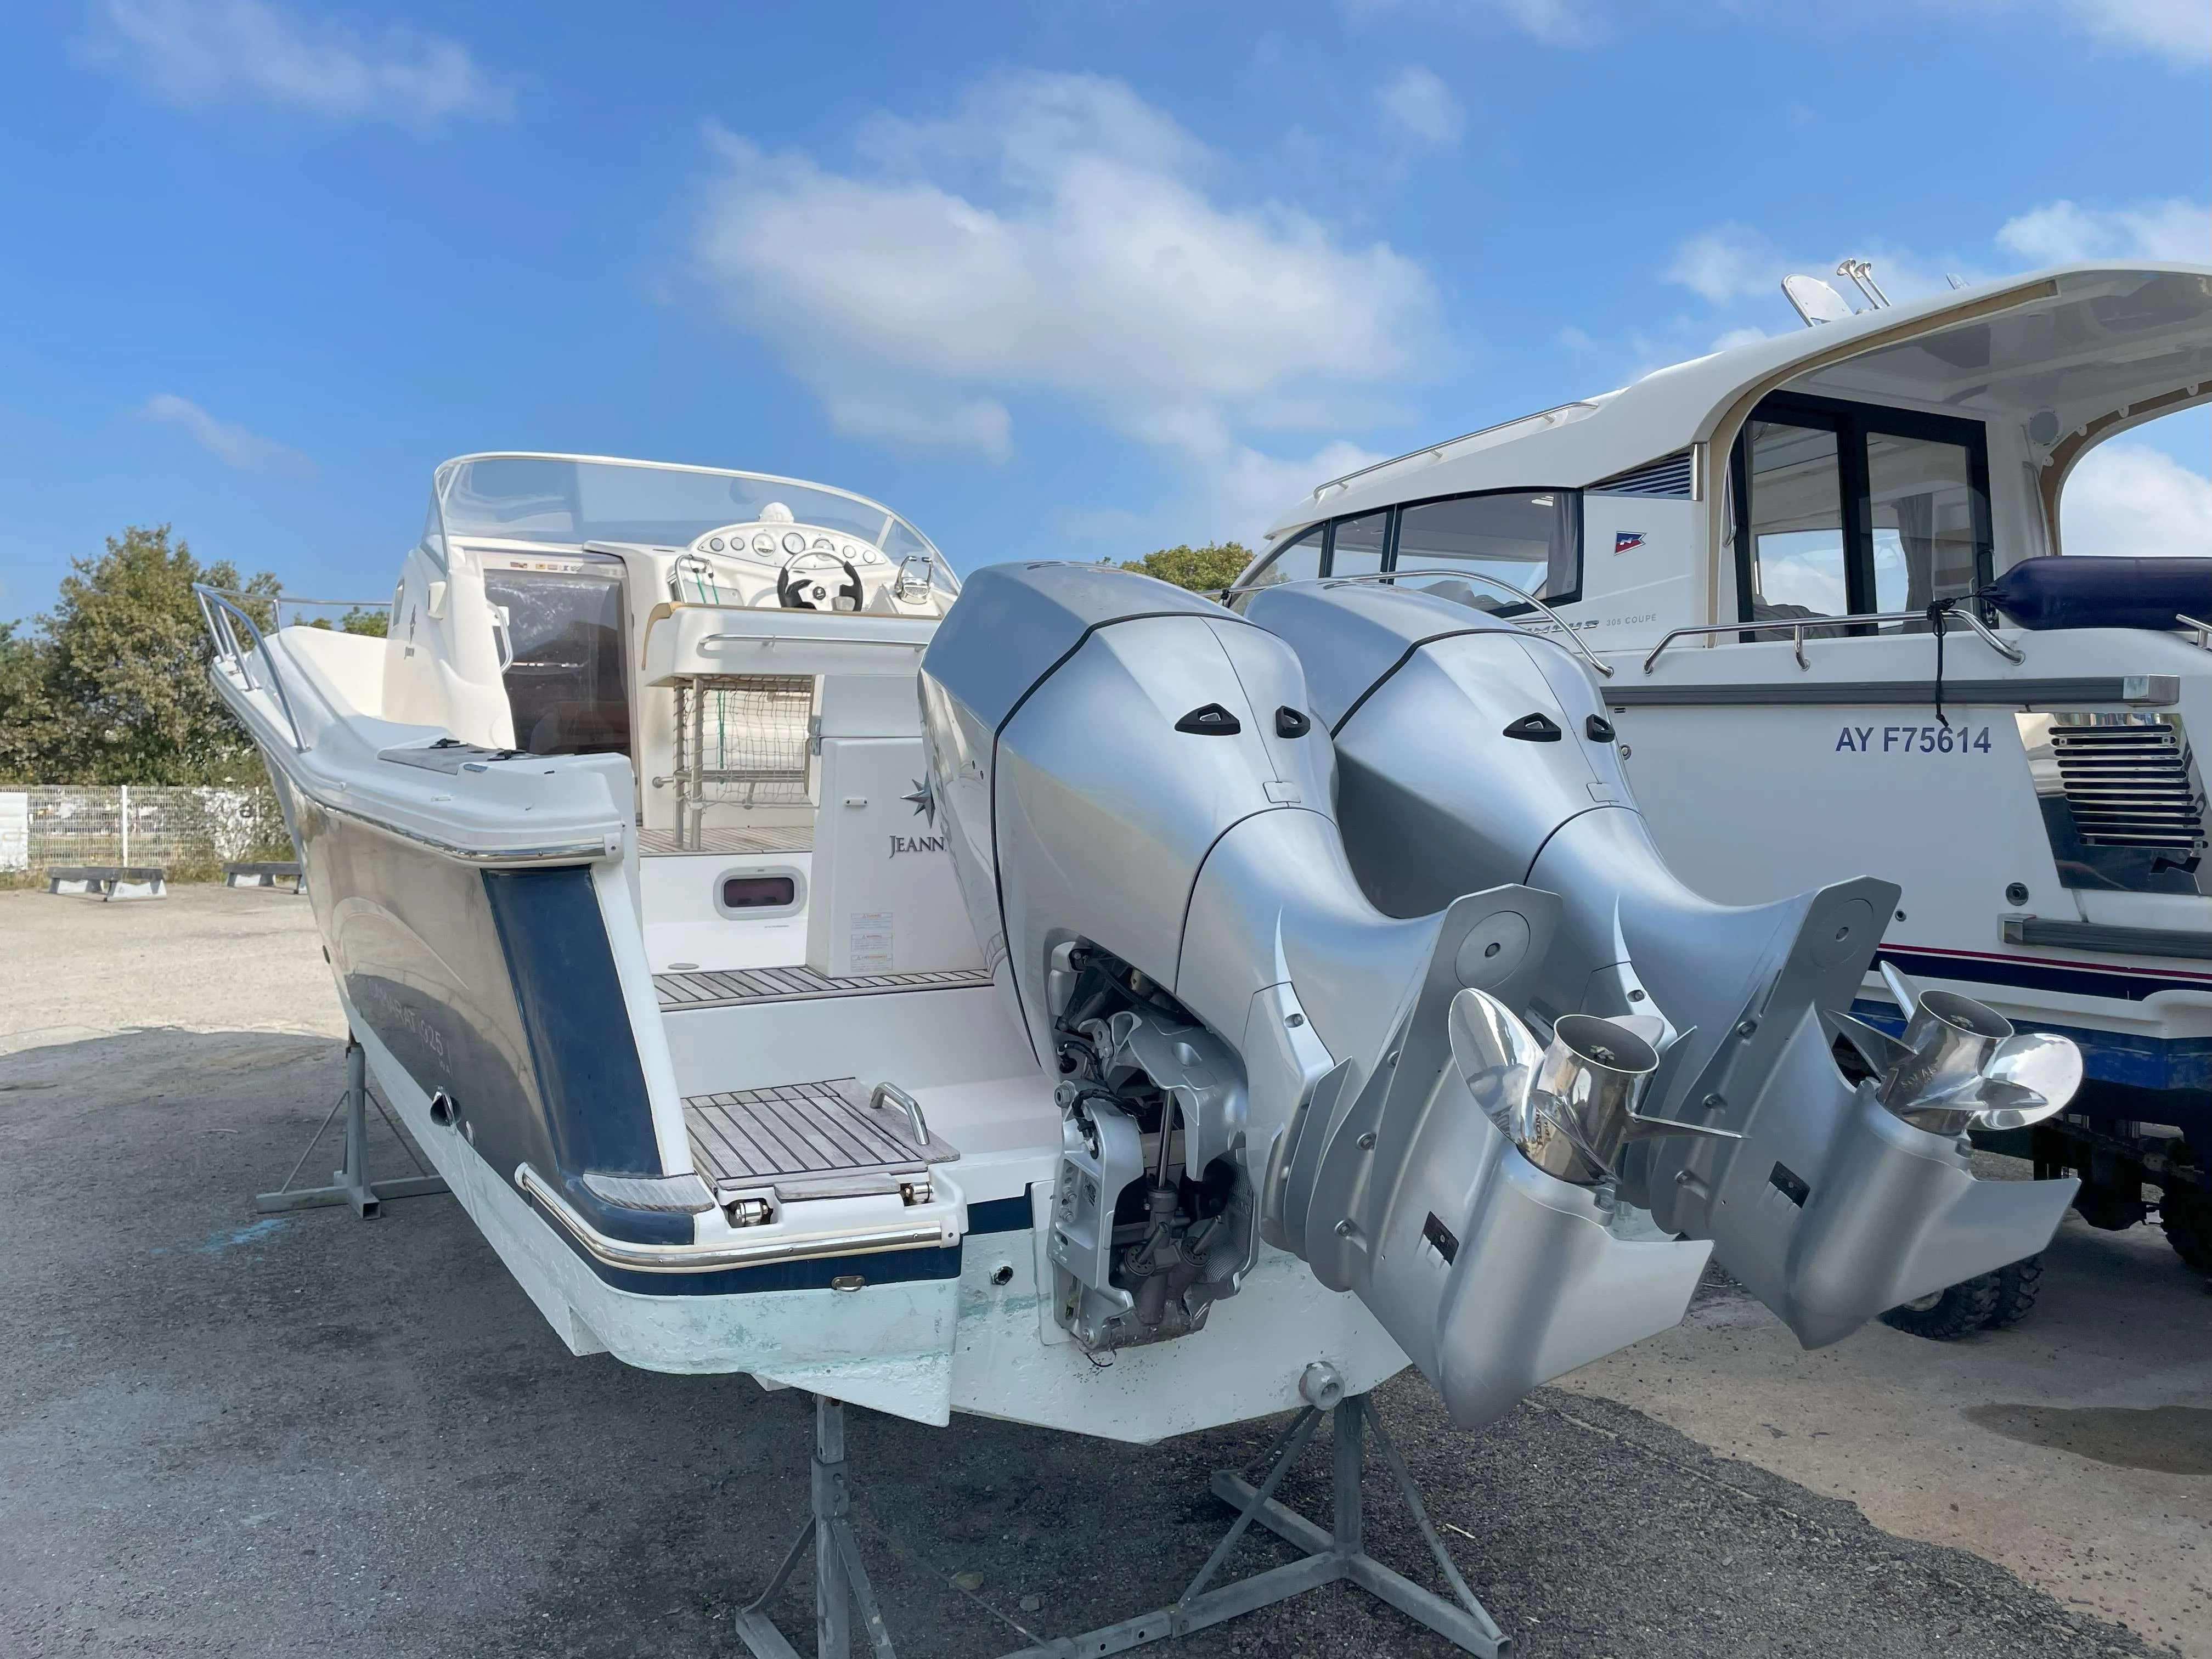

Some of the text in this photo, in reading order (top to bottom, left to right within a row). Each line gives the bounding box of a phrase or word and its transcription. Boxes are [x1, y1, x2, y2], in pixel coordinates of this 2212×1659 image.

[1606, 618, 1621, 627] 305
[1625, 613, 1656, 624] COUPÉ
[1835, 727, 1991, 753] AY F75614
[889, 835, 946, 859] JEANN
